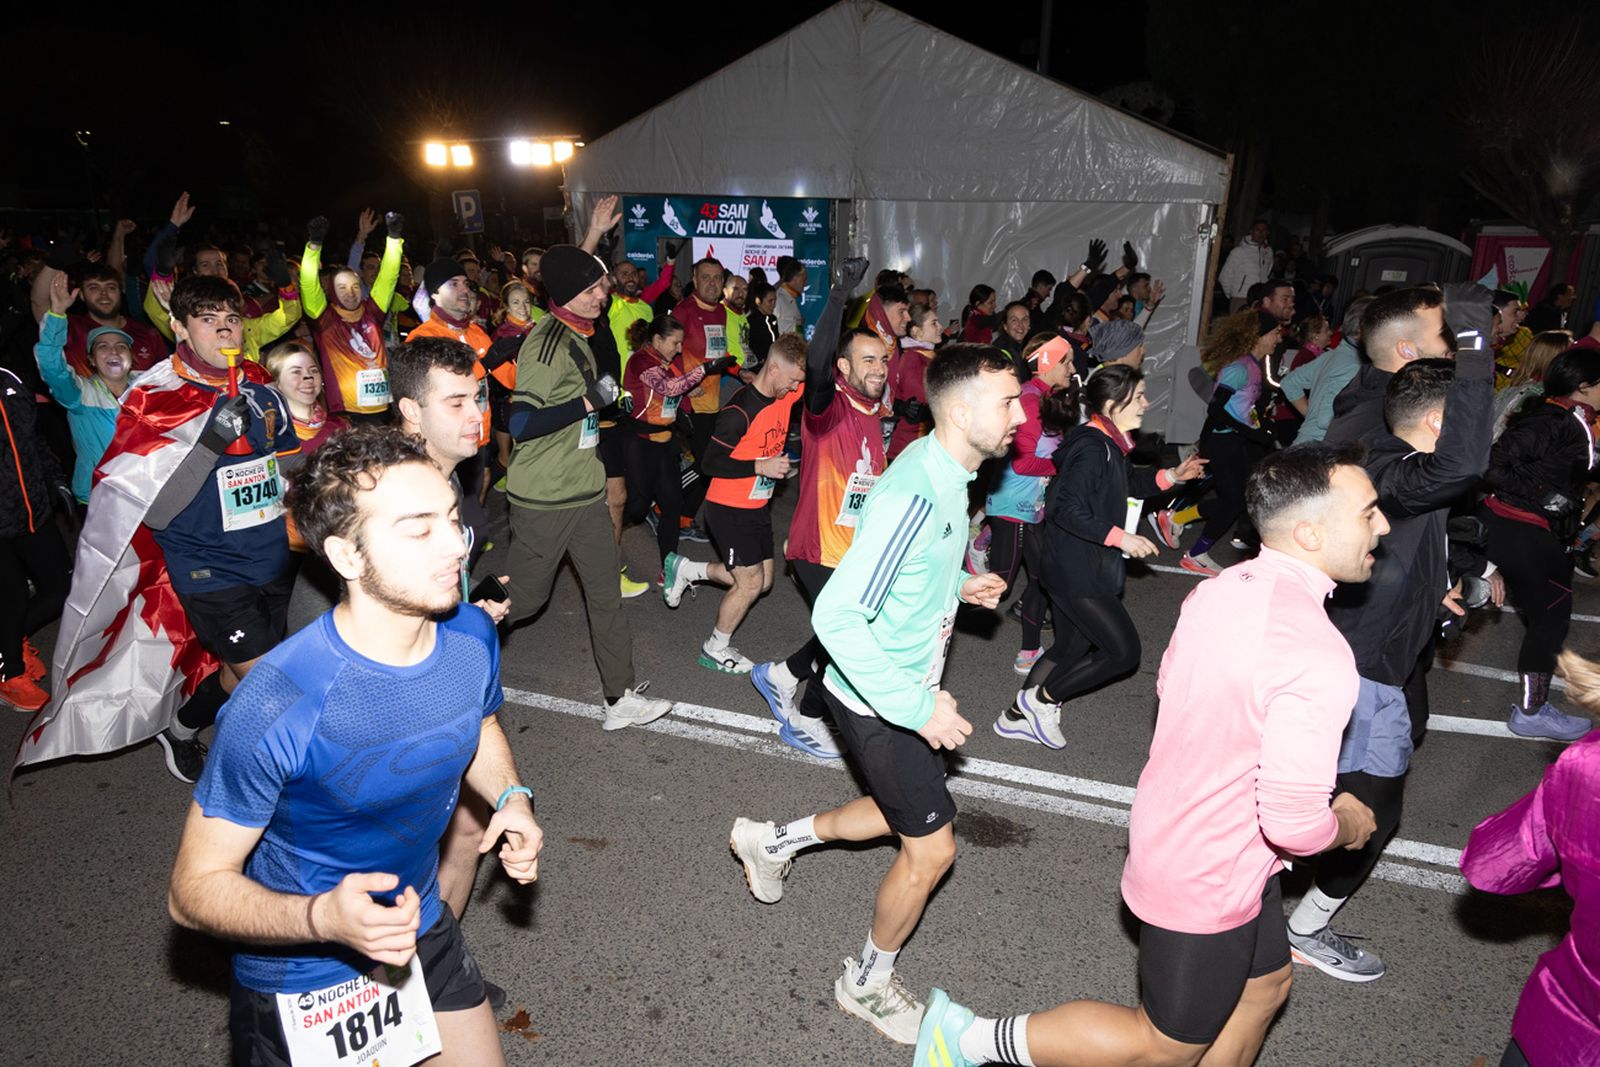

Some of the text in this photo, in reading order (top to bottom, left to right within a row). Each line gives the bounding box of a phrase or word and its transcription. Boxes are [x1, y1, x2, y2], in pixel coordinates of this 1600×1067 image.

[460, 196, 476, 219] P
[718, 203, 749, 219] SAN
[696, 216, 747, 235] ANTÓN
[743, 255, 766, 266] SAN
[364, 381, 389, 394] 13261
[235, 469, 256, 478] NOCHE
[227, 480, 242, 488] SAN
[231, 478, 278, 507] 13740
[318, 976, 361, 1006] NOCHE
[303, 1008, 334, 1029] SAN
[326, 991, 403, 1060] 1814
